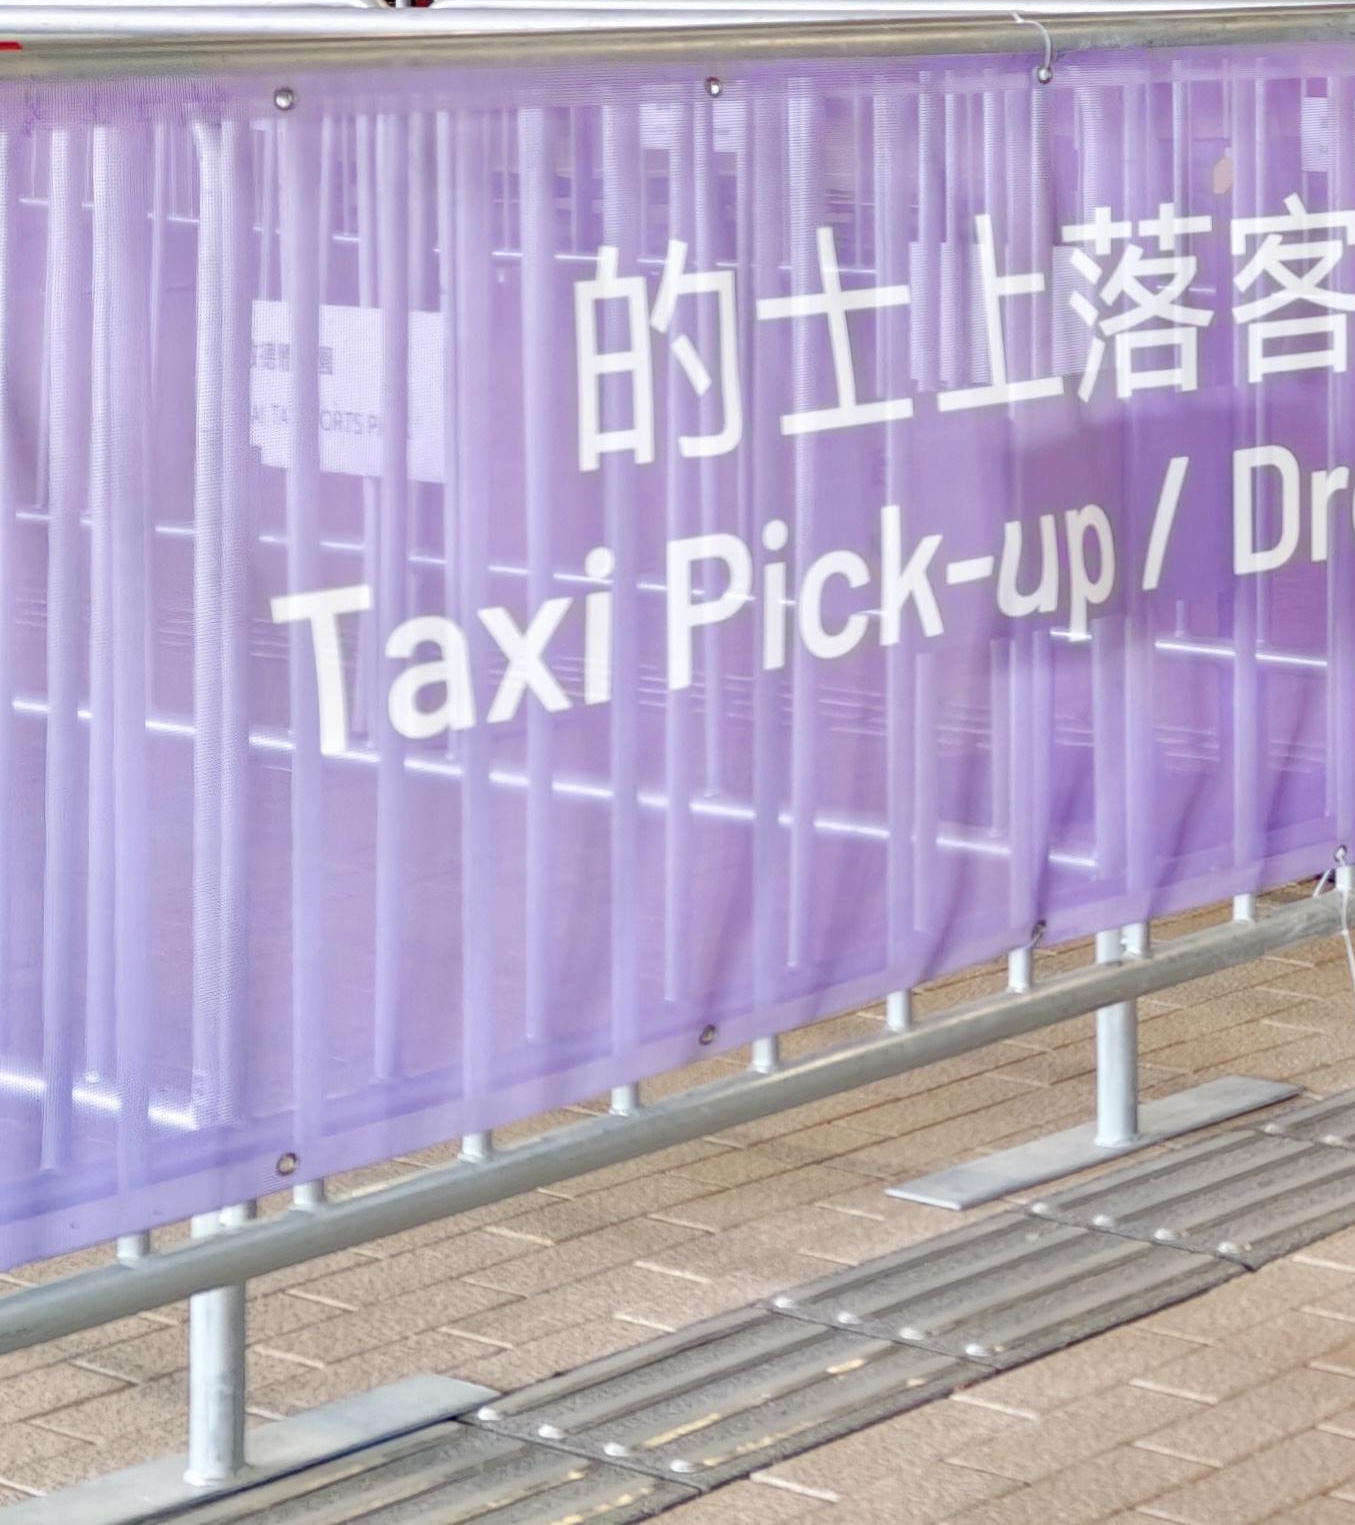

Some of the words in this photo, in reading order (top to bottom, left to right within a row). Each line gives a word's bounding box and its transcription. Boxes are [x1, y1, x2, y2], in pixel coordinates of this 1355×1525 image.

[269, 546, 616, 755] Taxi
[666, 504, 1116, 691] Pick-up
[1141, 456, 1190, 591] /
